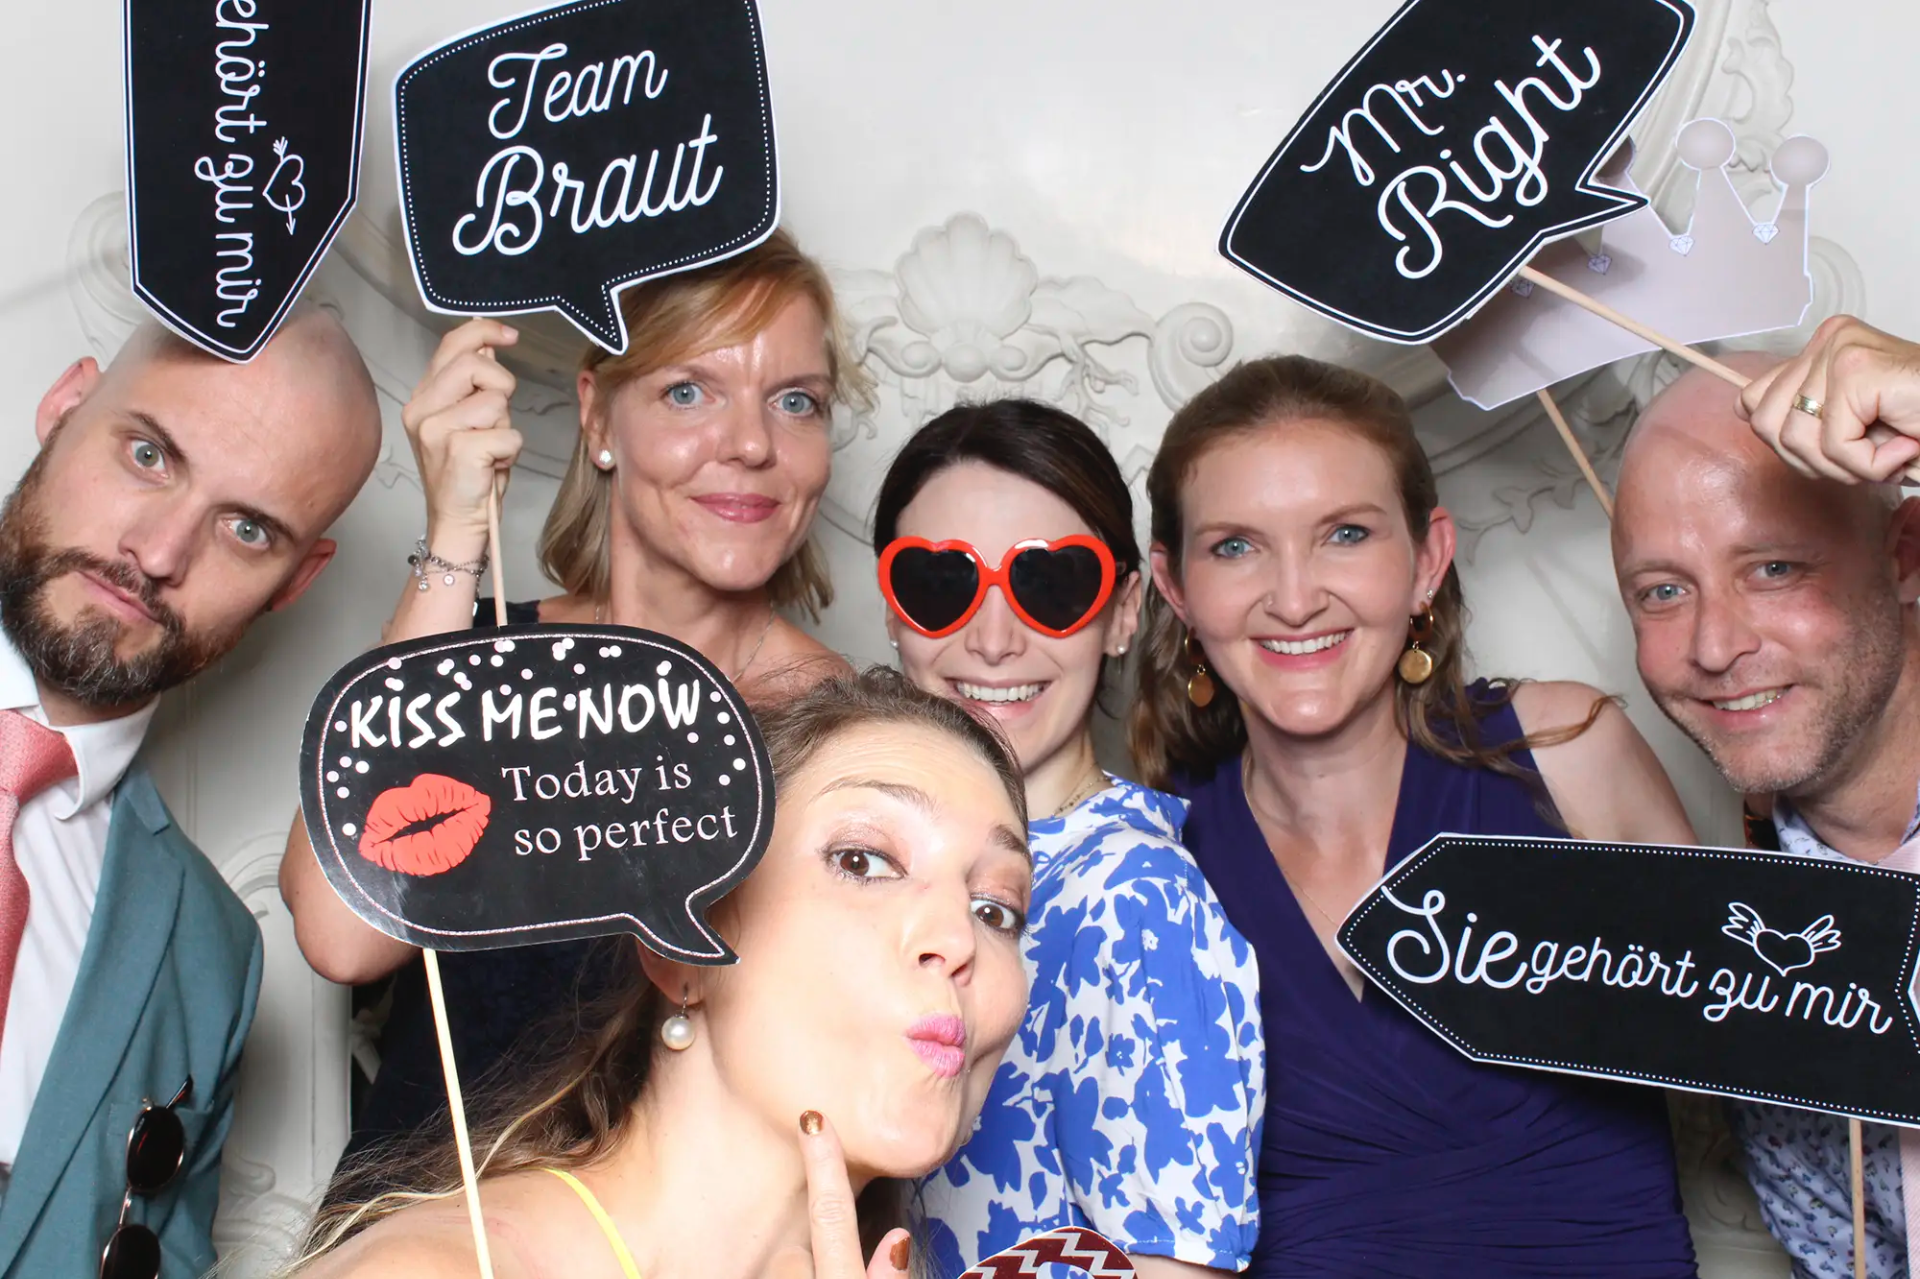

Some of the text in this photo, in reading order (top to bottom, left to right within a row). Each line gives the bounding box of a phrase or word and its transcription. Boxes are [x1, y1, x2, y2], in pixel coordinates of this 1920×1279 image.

[487, 42, 669, 140] Team
[1299, 68, 1466, 187] Mr.
[194, 153, 254, 223] zu
[452, 113, 724, 256] Braut
[1376, 34, 1601, 280] Right
[215, 232, 262, 328] mir
[350, 678, 701, 750] KISS ME NOW
[501, 754, 692, 805] Today is
[514, 805, 738, 862] so perfect
[1380, 885, 1893, 1035] Sie gehört zu mir
